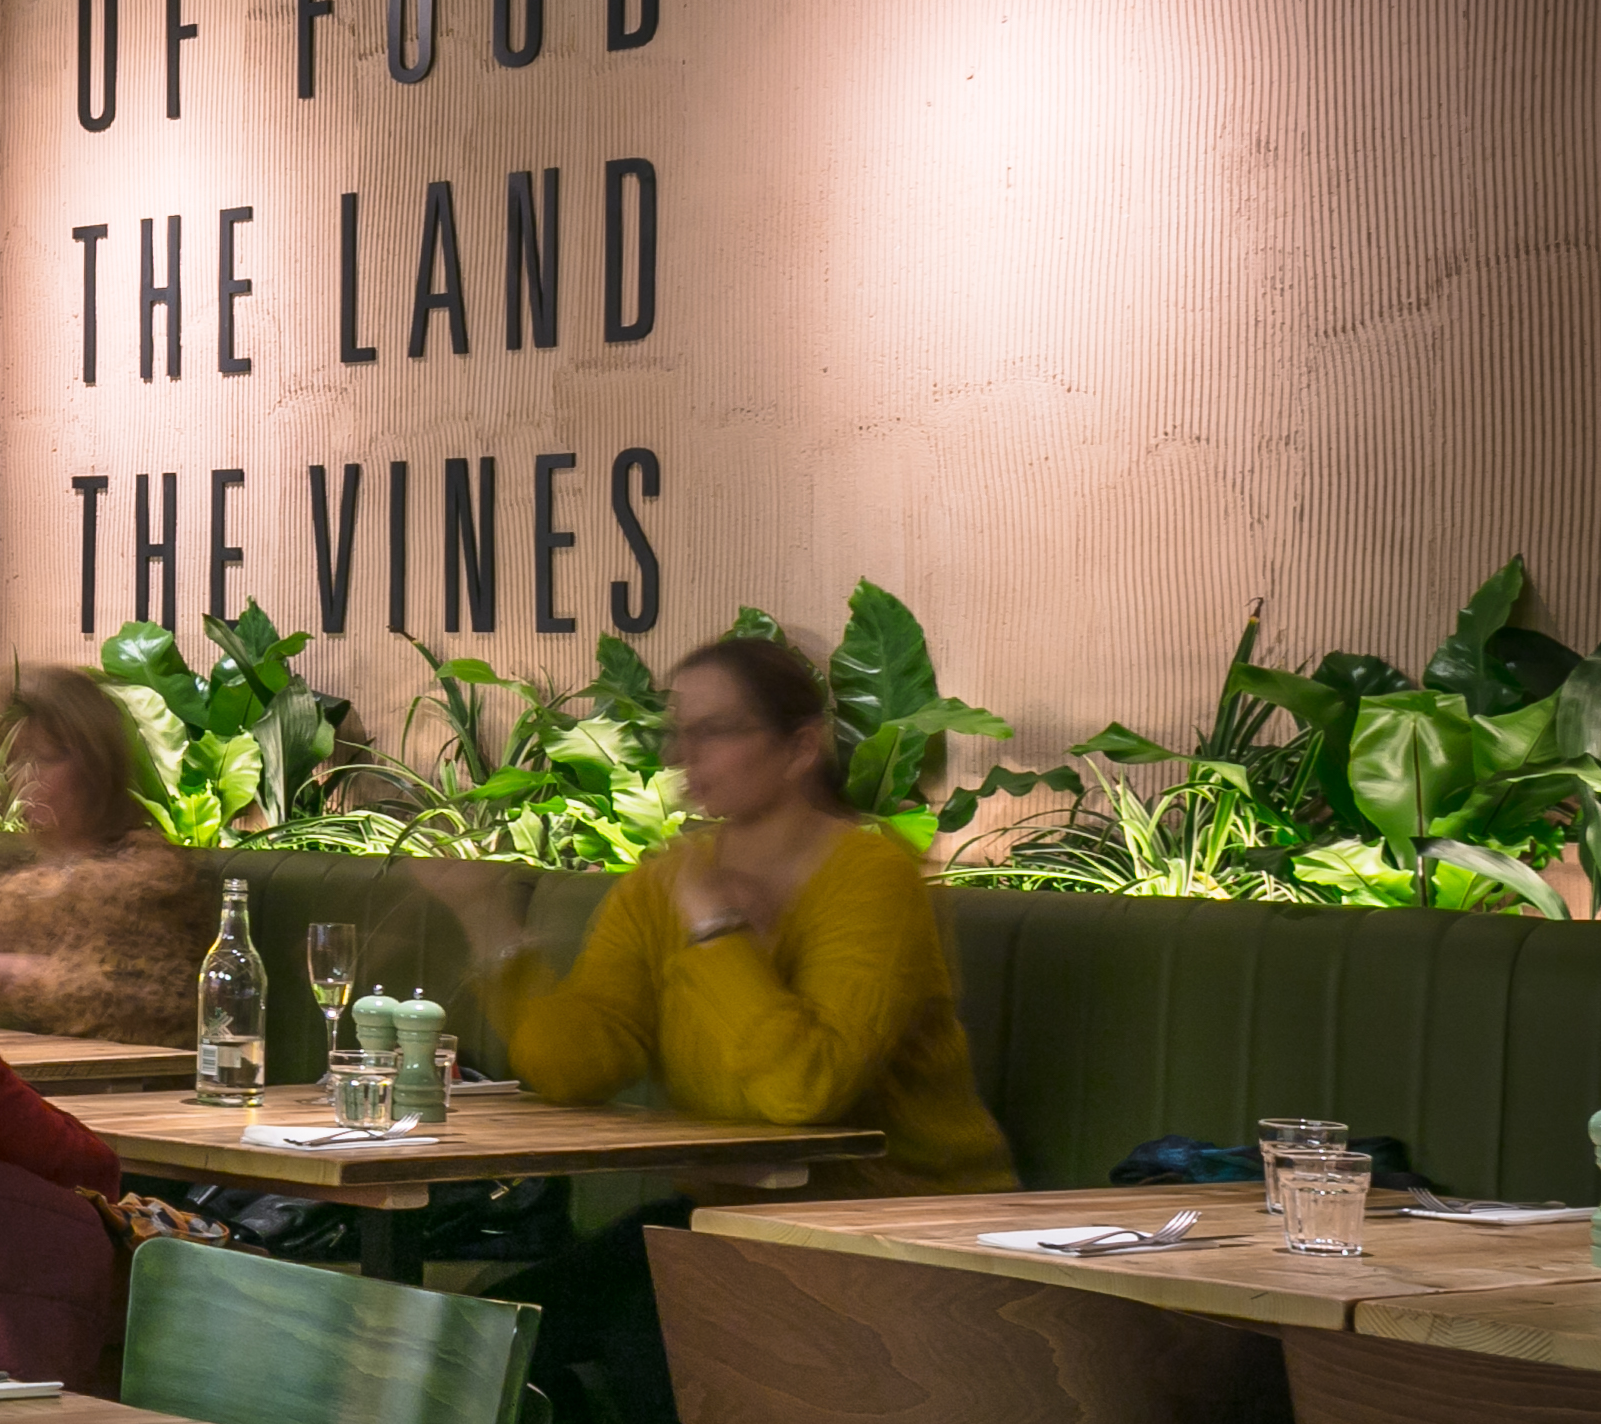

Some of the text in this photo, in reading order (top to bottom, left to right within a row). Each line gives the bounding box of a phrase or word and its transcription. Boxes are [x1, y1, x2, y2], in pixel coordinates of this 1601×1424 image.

[72, 157, 659, 385] THE LAND
[71, 447, 661, 634] THE VINES
